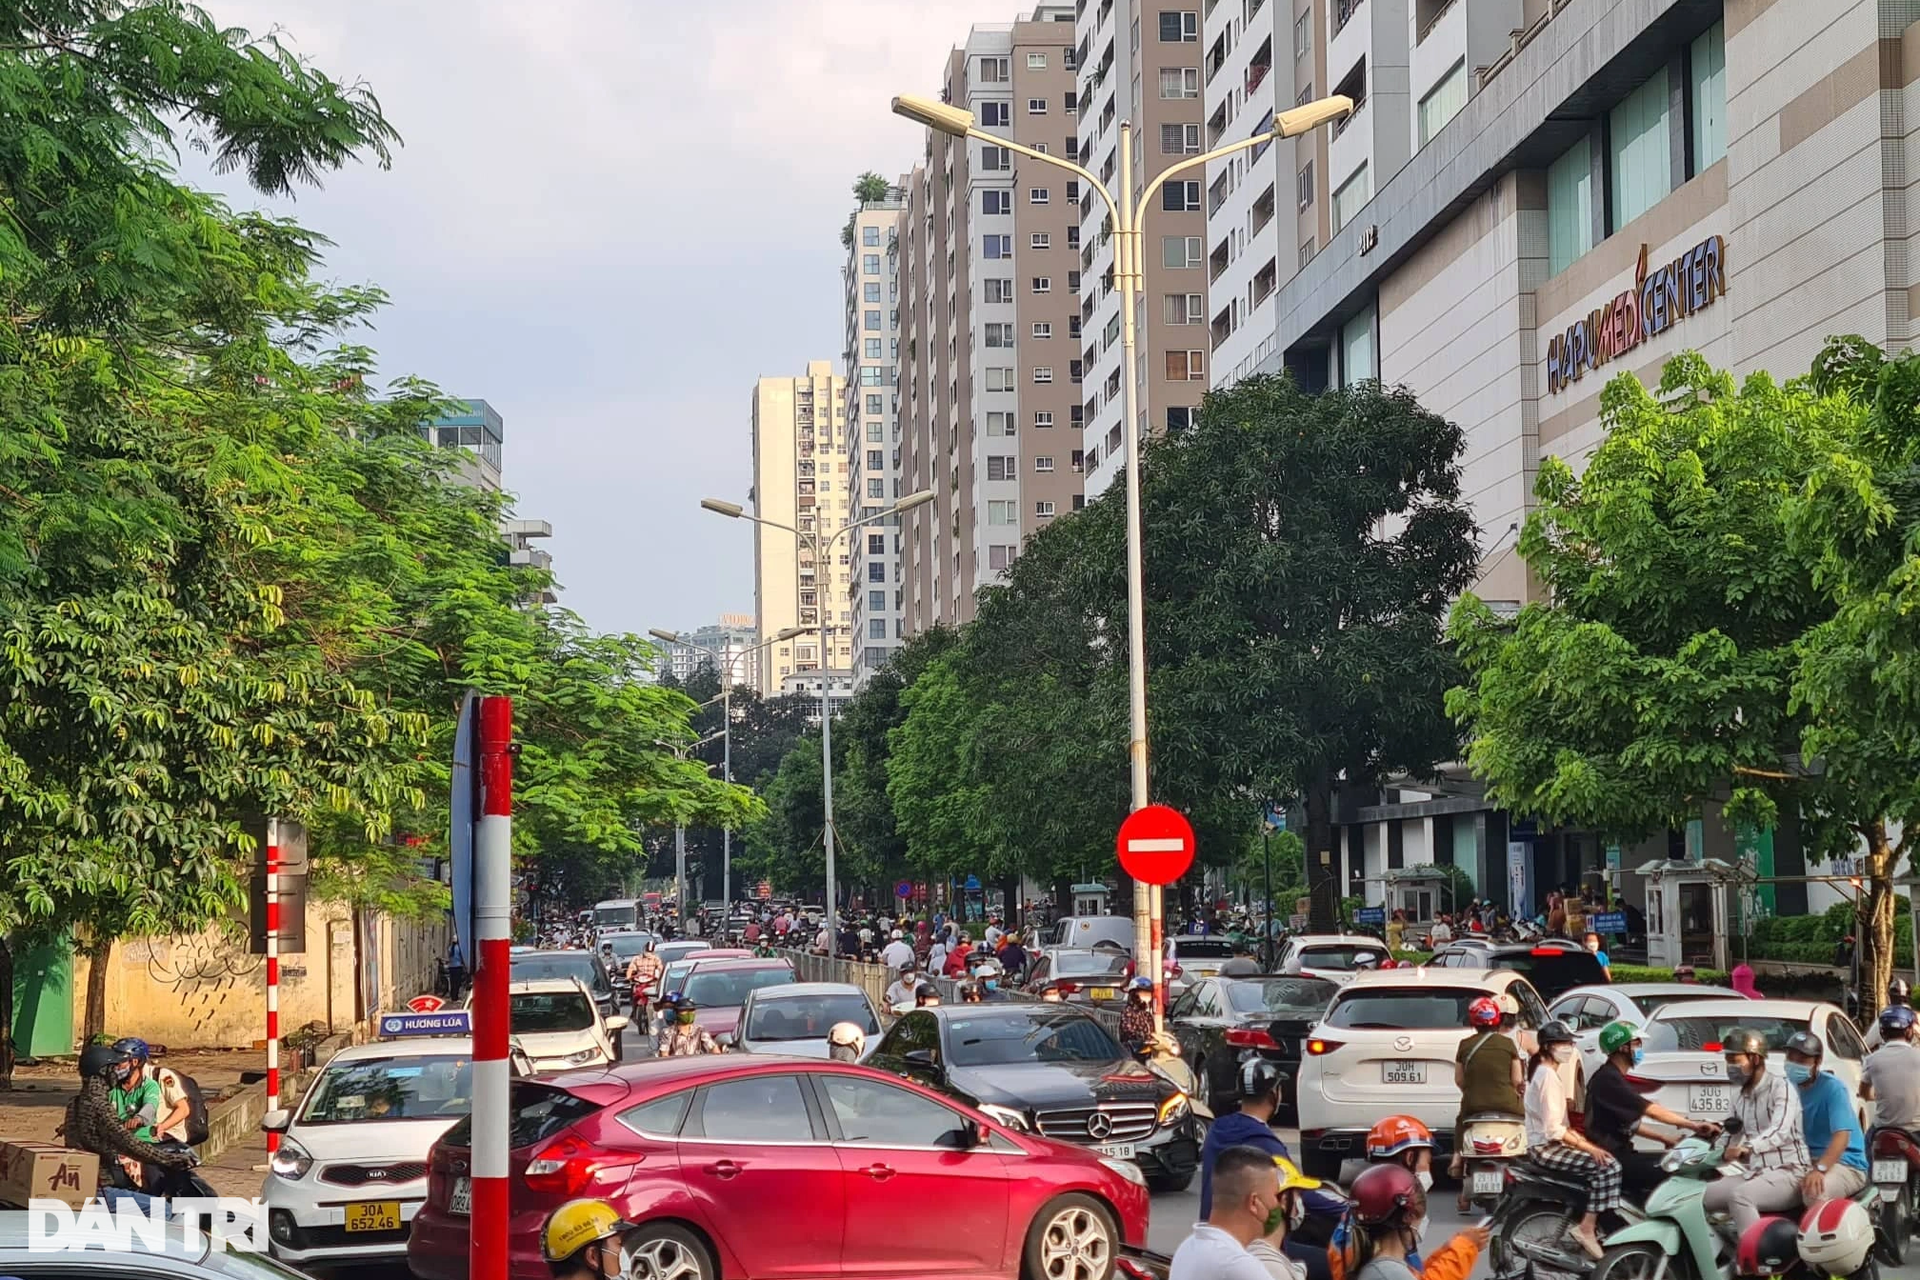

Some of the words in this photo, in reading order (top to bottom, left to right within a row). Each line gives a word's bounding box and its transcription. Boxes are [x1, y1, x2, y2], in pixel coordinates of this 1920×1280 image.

[1387, 1072, 1421, 1082] 509.61
[1691, 1098, 1730, 1111] 435.83
[361, 1204, 384, 1217] 30A
[351, 1217, 394, 1230] 652.46
